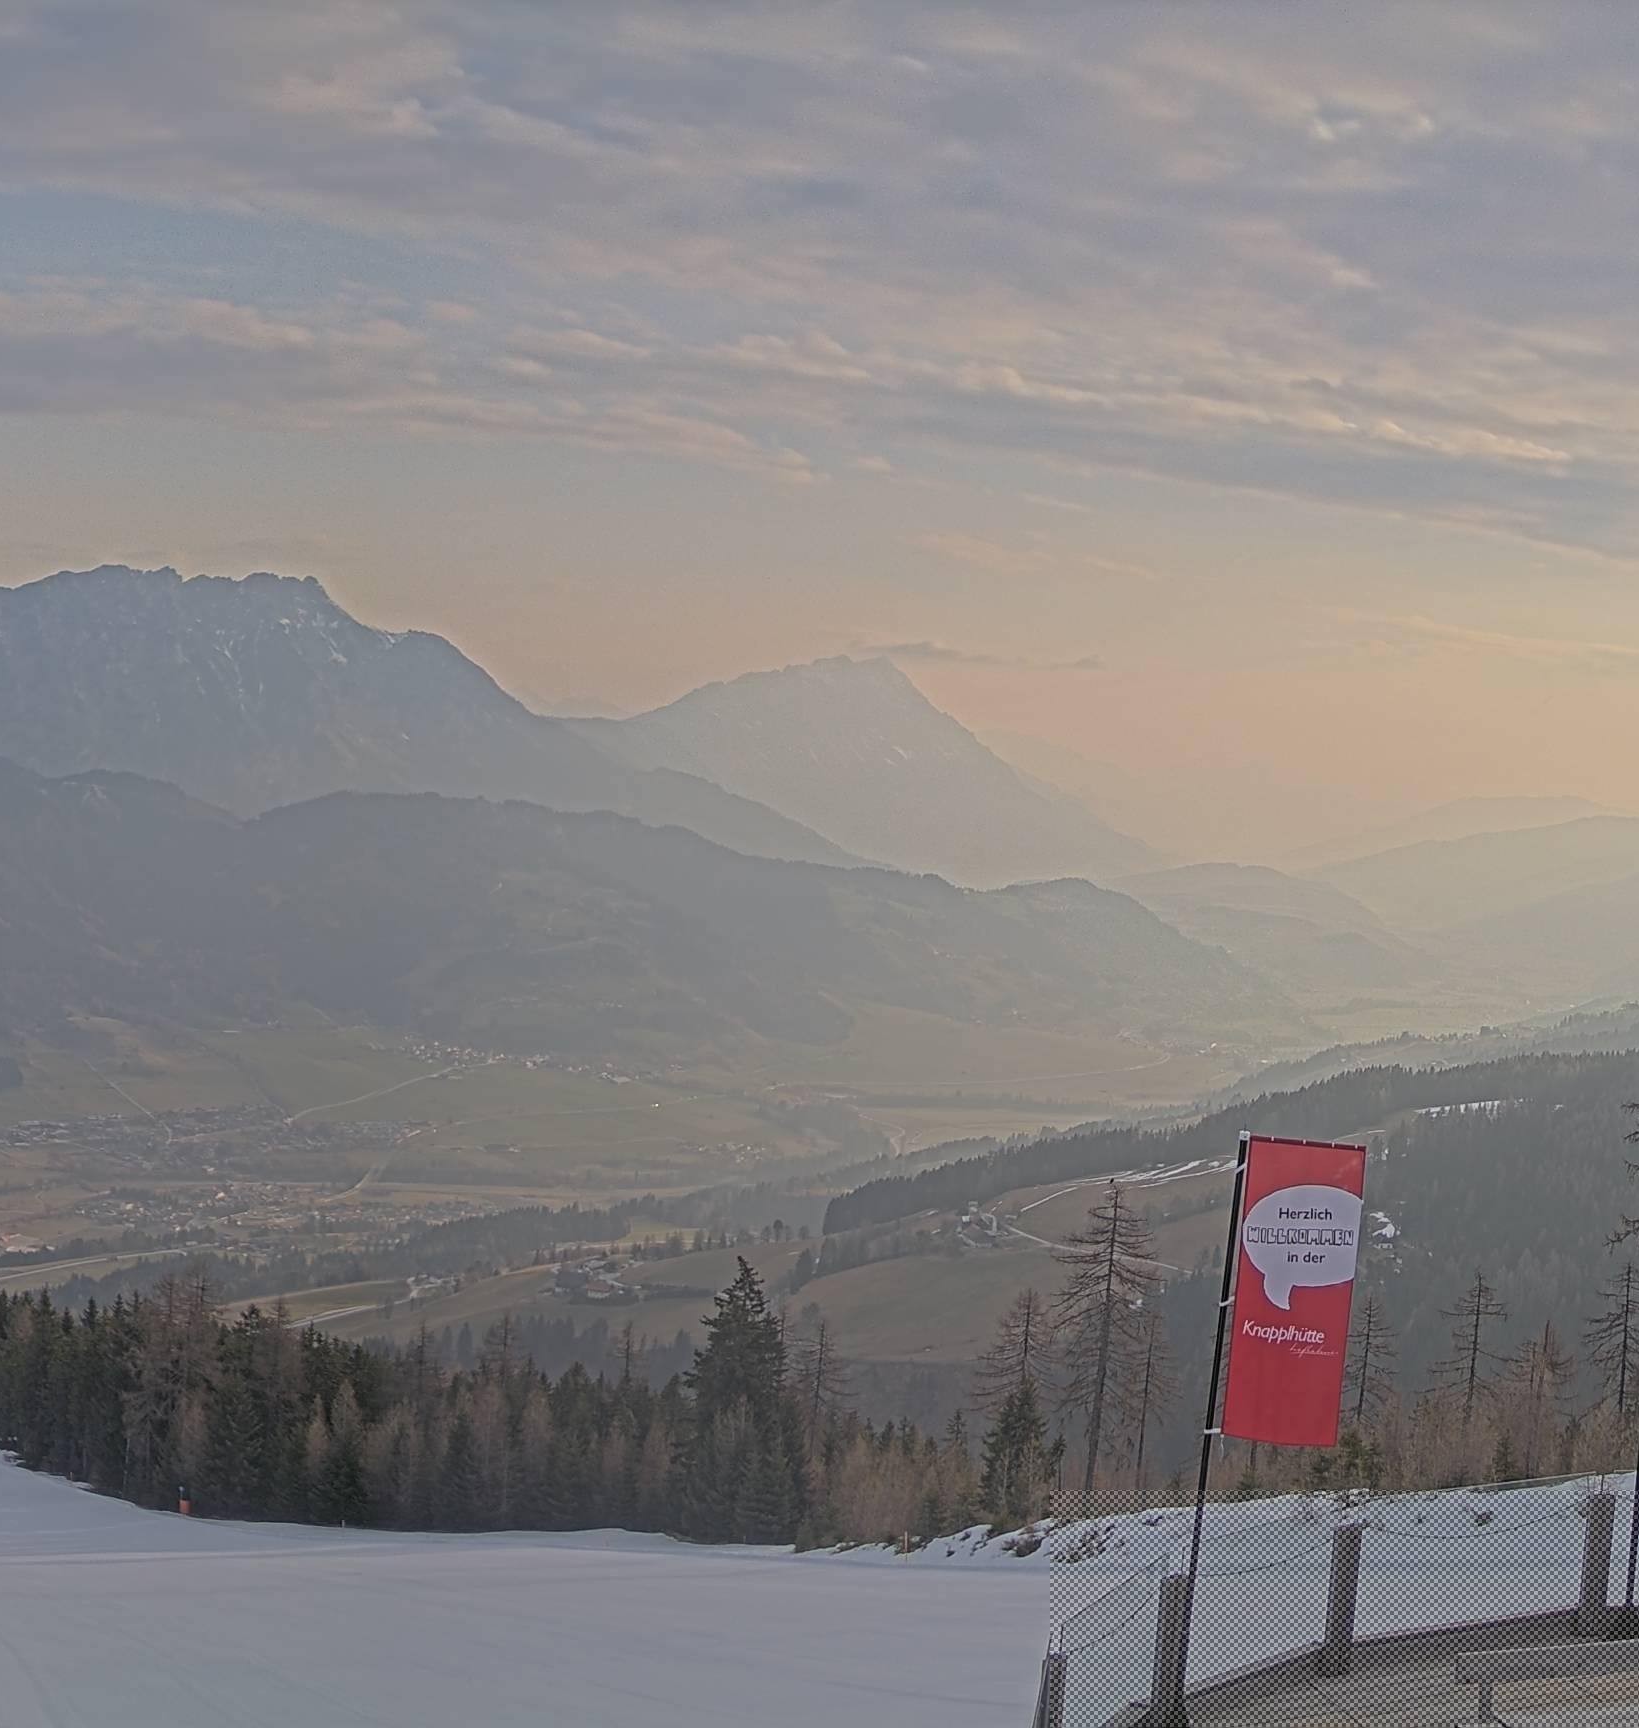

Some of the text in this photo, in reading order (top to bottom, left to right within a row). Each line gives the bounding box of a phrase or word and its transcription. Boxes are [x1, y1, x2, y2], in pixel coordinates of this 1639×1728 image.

[1279, 1207, 1333, 1220] Herzlich
[1247, 1226, 1354, 1246] WILLKOMMEN
[1287, 1252, 1326, 1264] in der
[1242, 1320, 1325, 1344] Knapplhütte
